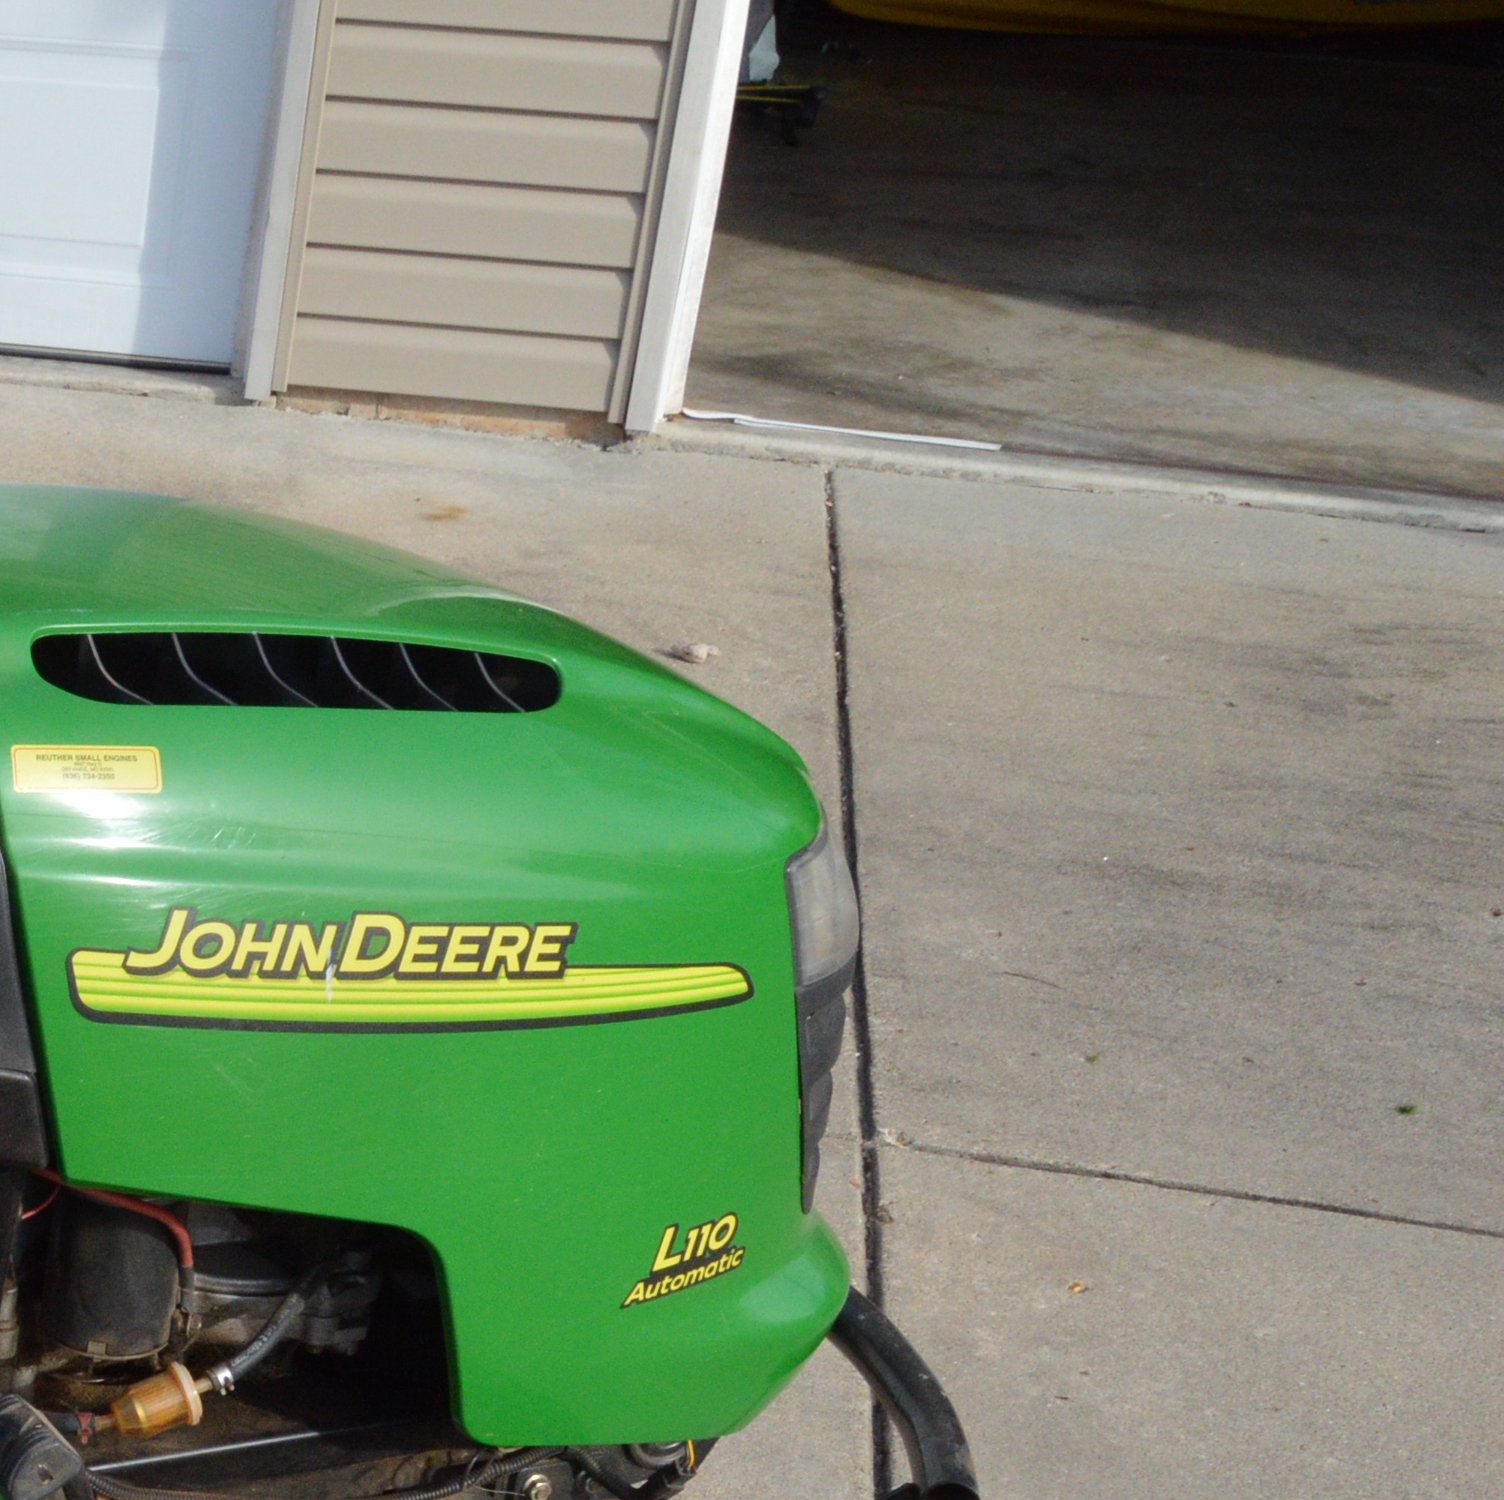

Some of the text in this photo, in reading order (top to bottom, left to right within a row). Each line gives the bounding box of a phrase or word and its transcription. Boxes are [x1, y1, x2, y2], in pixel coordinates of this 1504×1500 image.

[122, 906, 578, 981] JOHN DEERE
[651, 1213, 738, 1273] L110
[622, 1247, 745, 1307] Automatic
